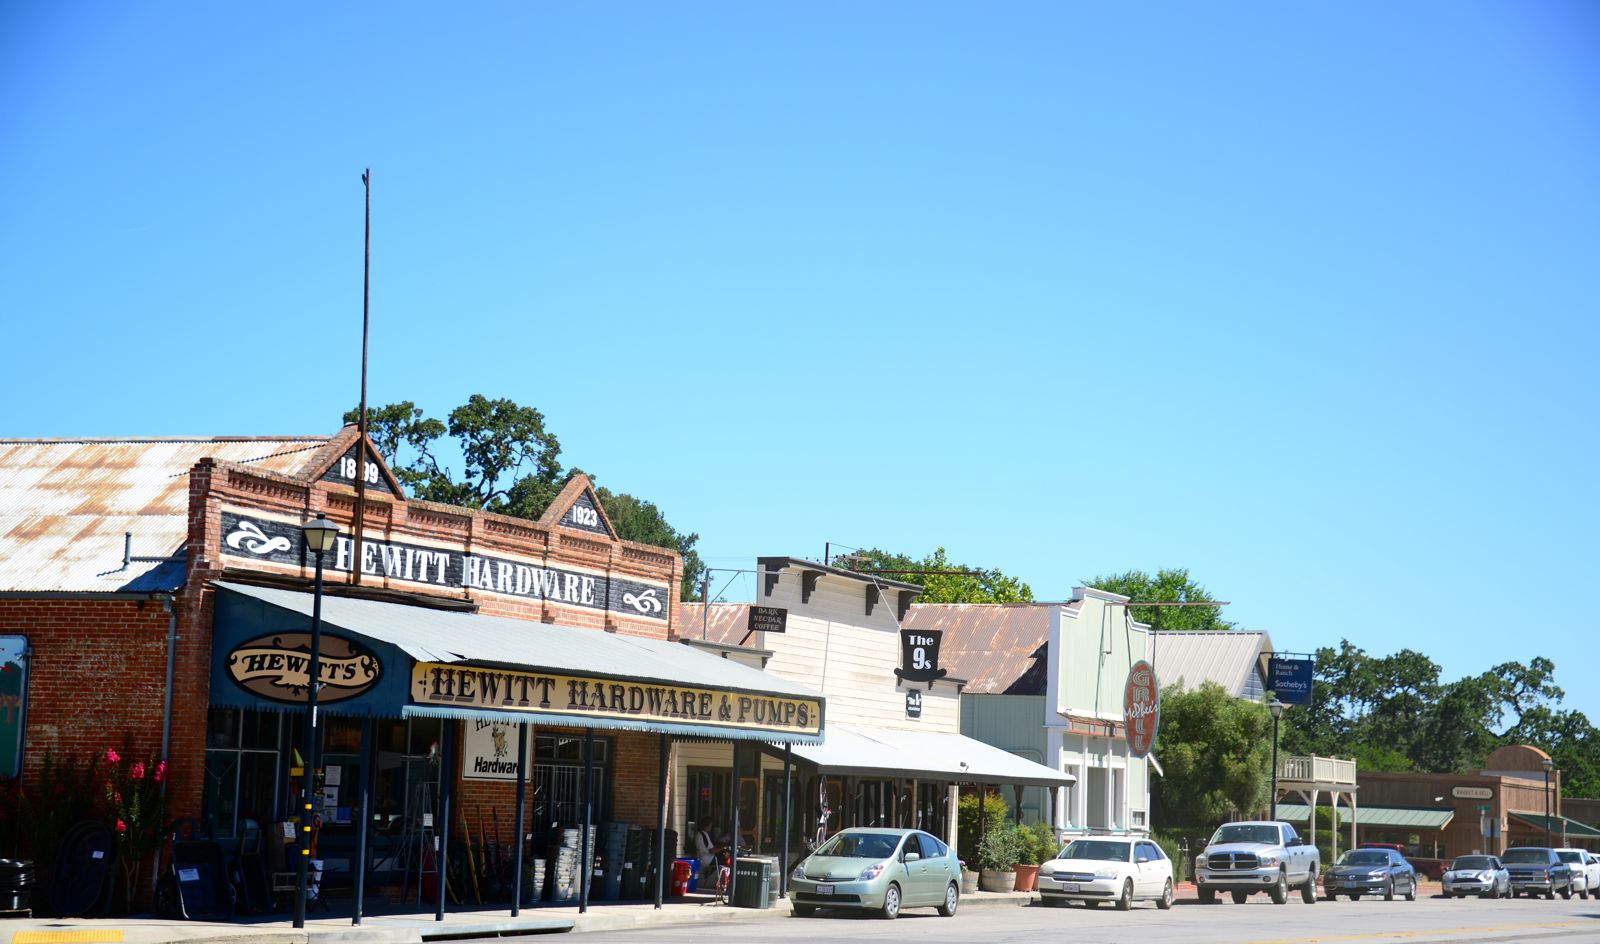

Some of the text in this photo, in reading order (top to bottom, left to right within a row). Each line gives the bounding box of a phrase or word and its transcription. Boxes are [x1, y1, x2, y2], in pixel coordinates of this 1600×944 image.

[572, 505, 598, 527] 1923
[335, 536, 595, 605] HEWITT HARDWARE
[753, 615, 782, 624] NECTAR
[758, 608, 778, 616] DARK
[754, 623, 779, 631] COFFEE
[908, 634, 934, 646] The
[912, 647, 932, 670] 9s
[1275, 680, 1308, 690] Sotheby's
[430, 667, 809, 728] HEWITT HARDWARE & PUMPS
[474, 756, 519, 774] Hardwar
